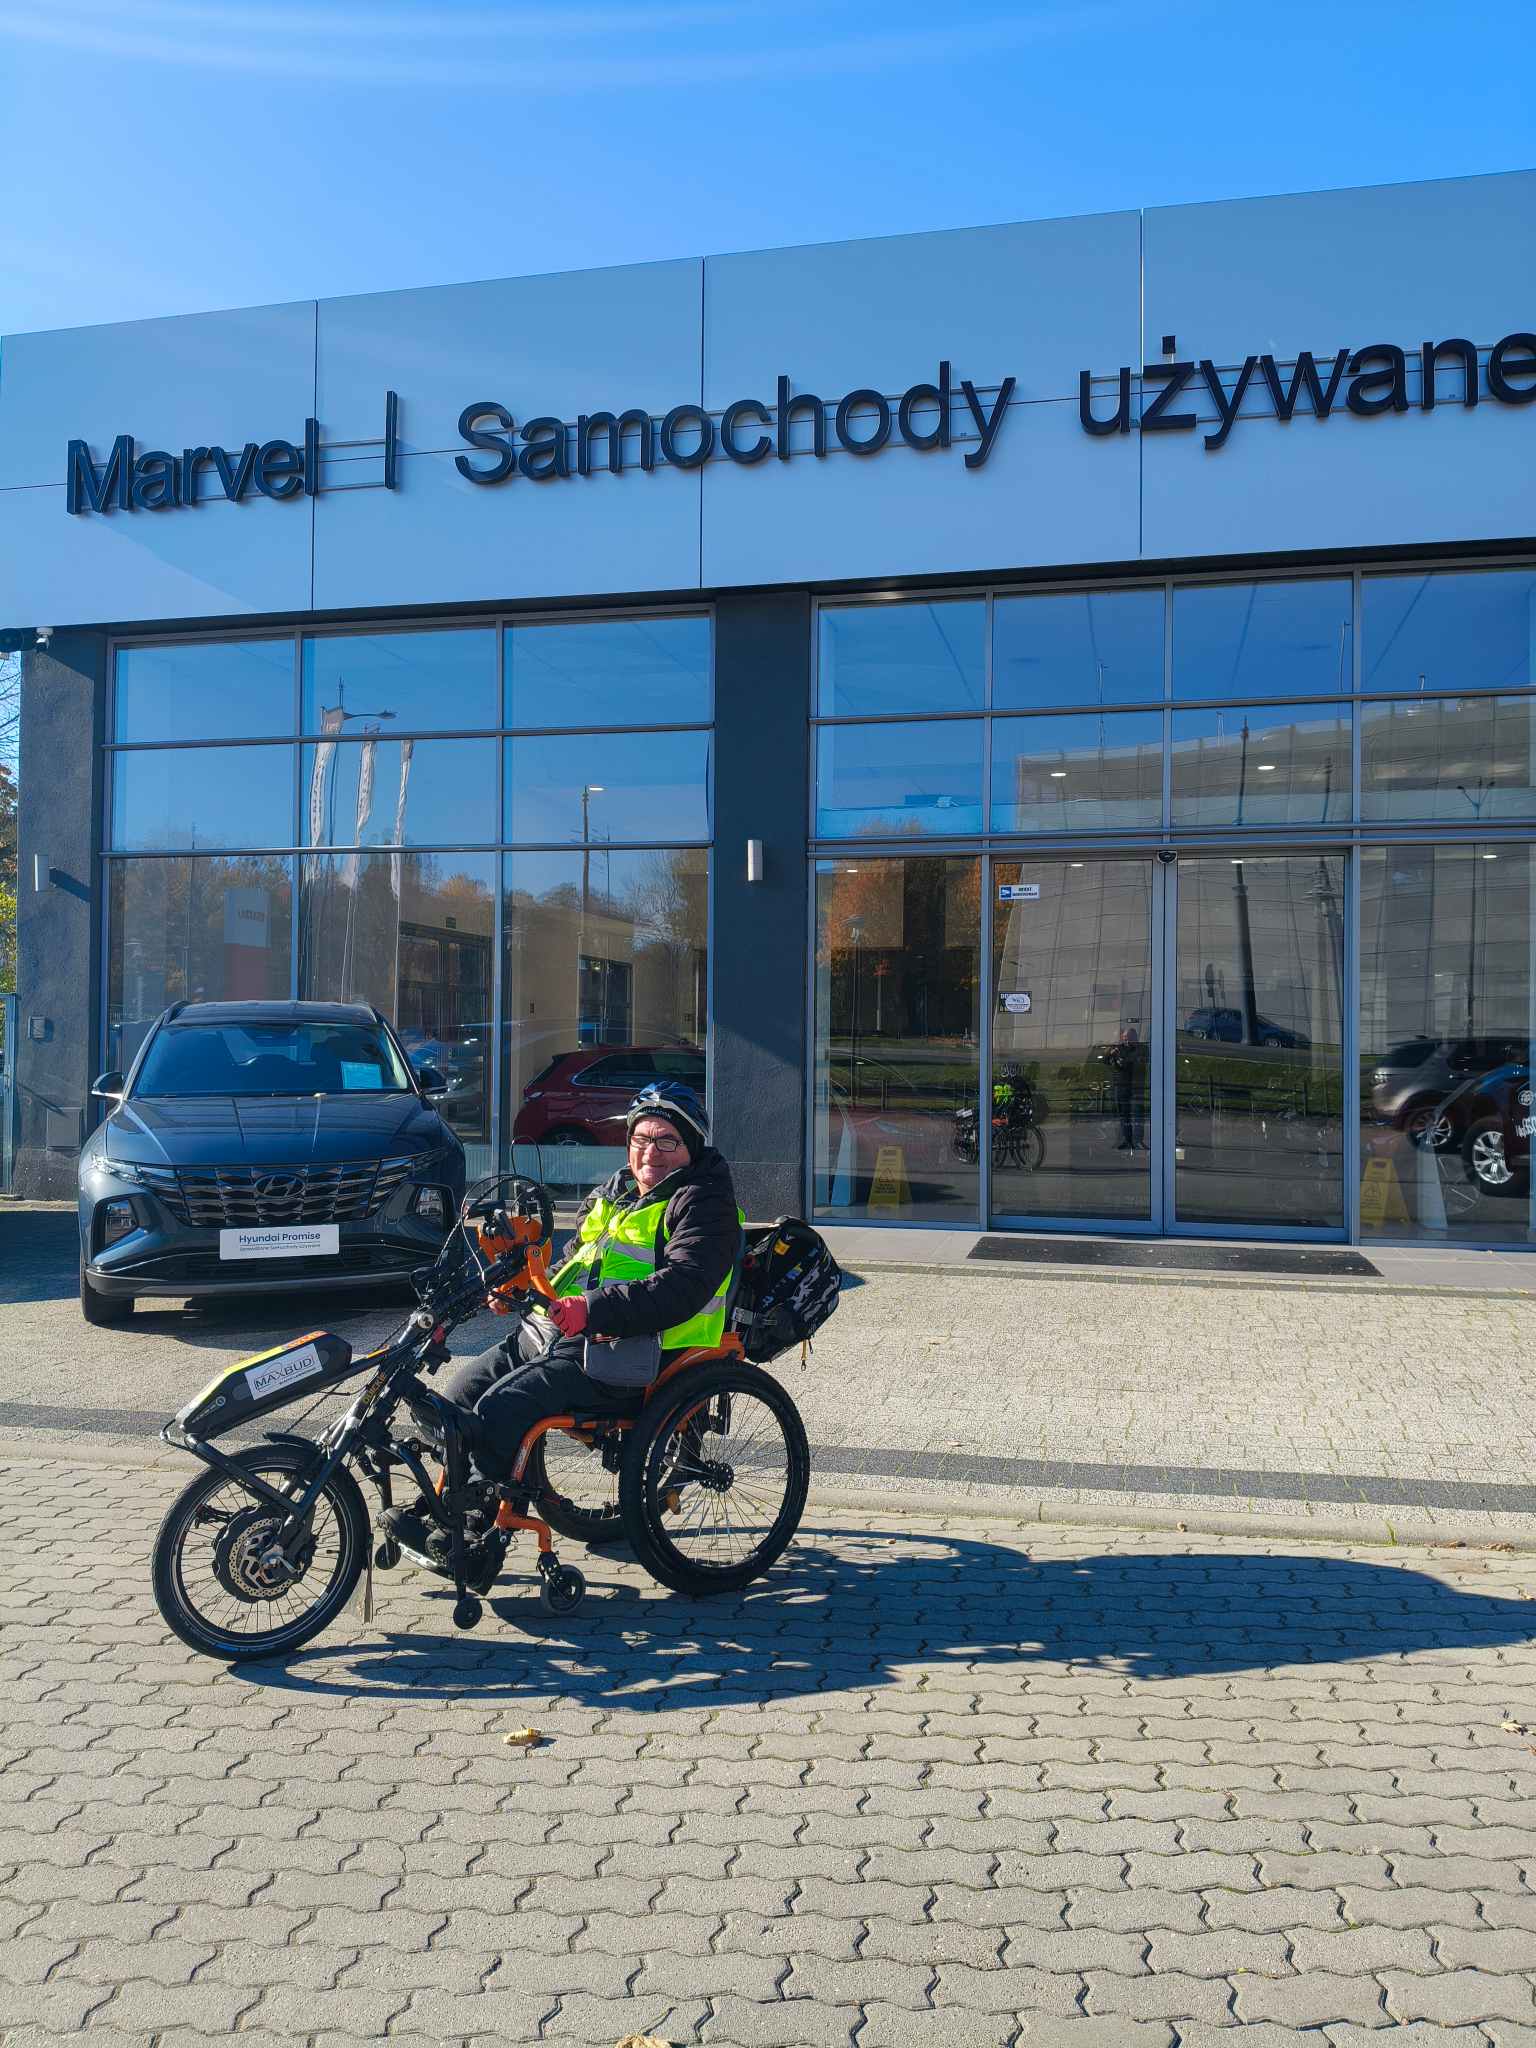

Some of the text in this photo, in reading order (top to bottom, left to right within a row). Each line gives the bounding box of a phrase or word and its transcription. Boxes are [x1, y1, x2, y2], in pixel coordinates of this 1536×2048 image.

[66, 417, 320, 515] Marvel
[454, 360, 1017, 485] Samochody
[1079, 332, 1536, 450] używane
[240, 1231, 321, 1244] Hyundai Promise
[255, 1357, 313, 1390] MAXBUD
